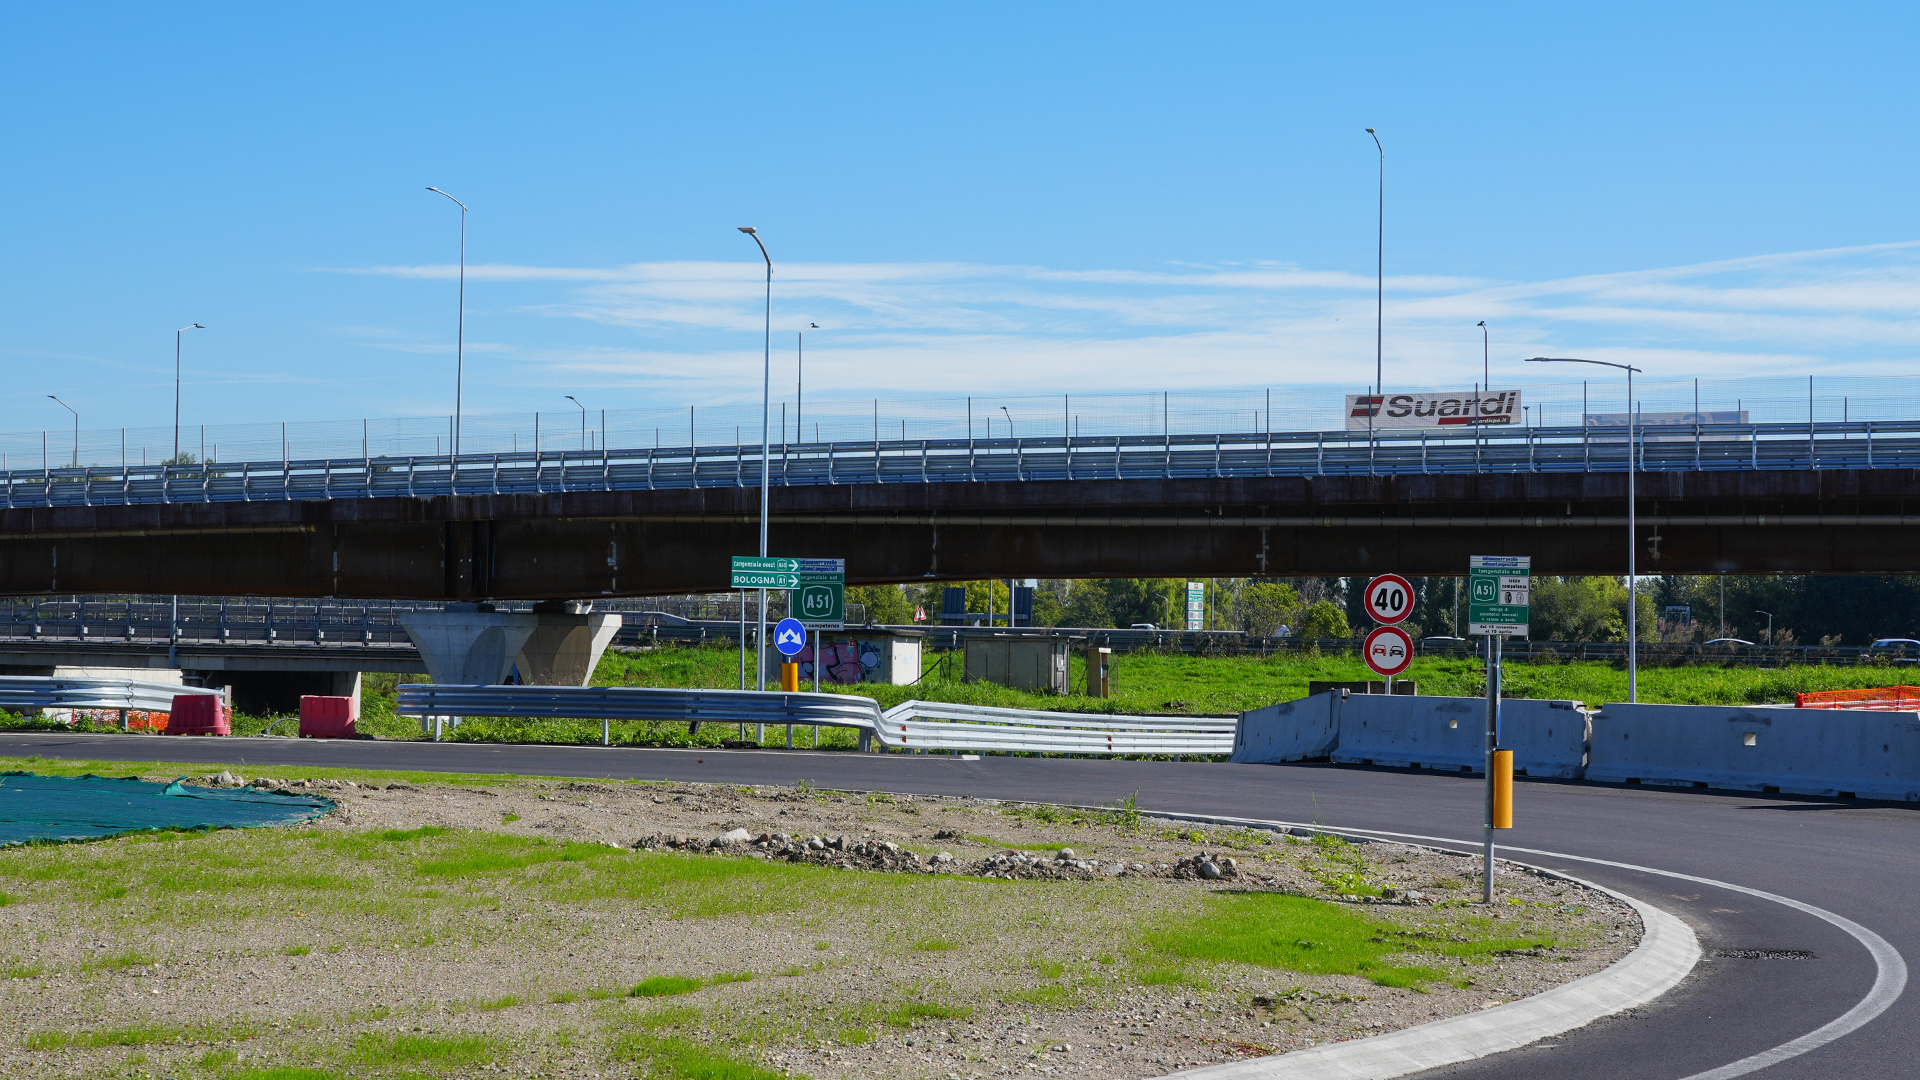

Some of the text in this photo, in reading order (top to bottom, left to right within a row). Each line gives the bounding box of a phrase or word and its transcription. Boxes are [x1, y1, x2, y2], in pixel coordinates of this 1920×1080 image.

[1386, 392, 1516, 417] Suardi
[733, 560, 762, 568] tangenziale
[733, 575, 776, 584] BOLOGNA
[778, 577, 786, 585] A1
[1476, 585, 1493, 596] A51
[806, 594, 829, 609] A51
[1374, 587, 1404, 612] 40
